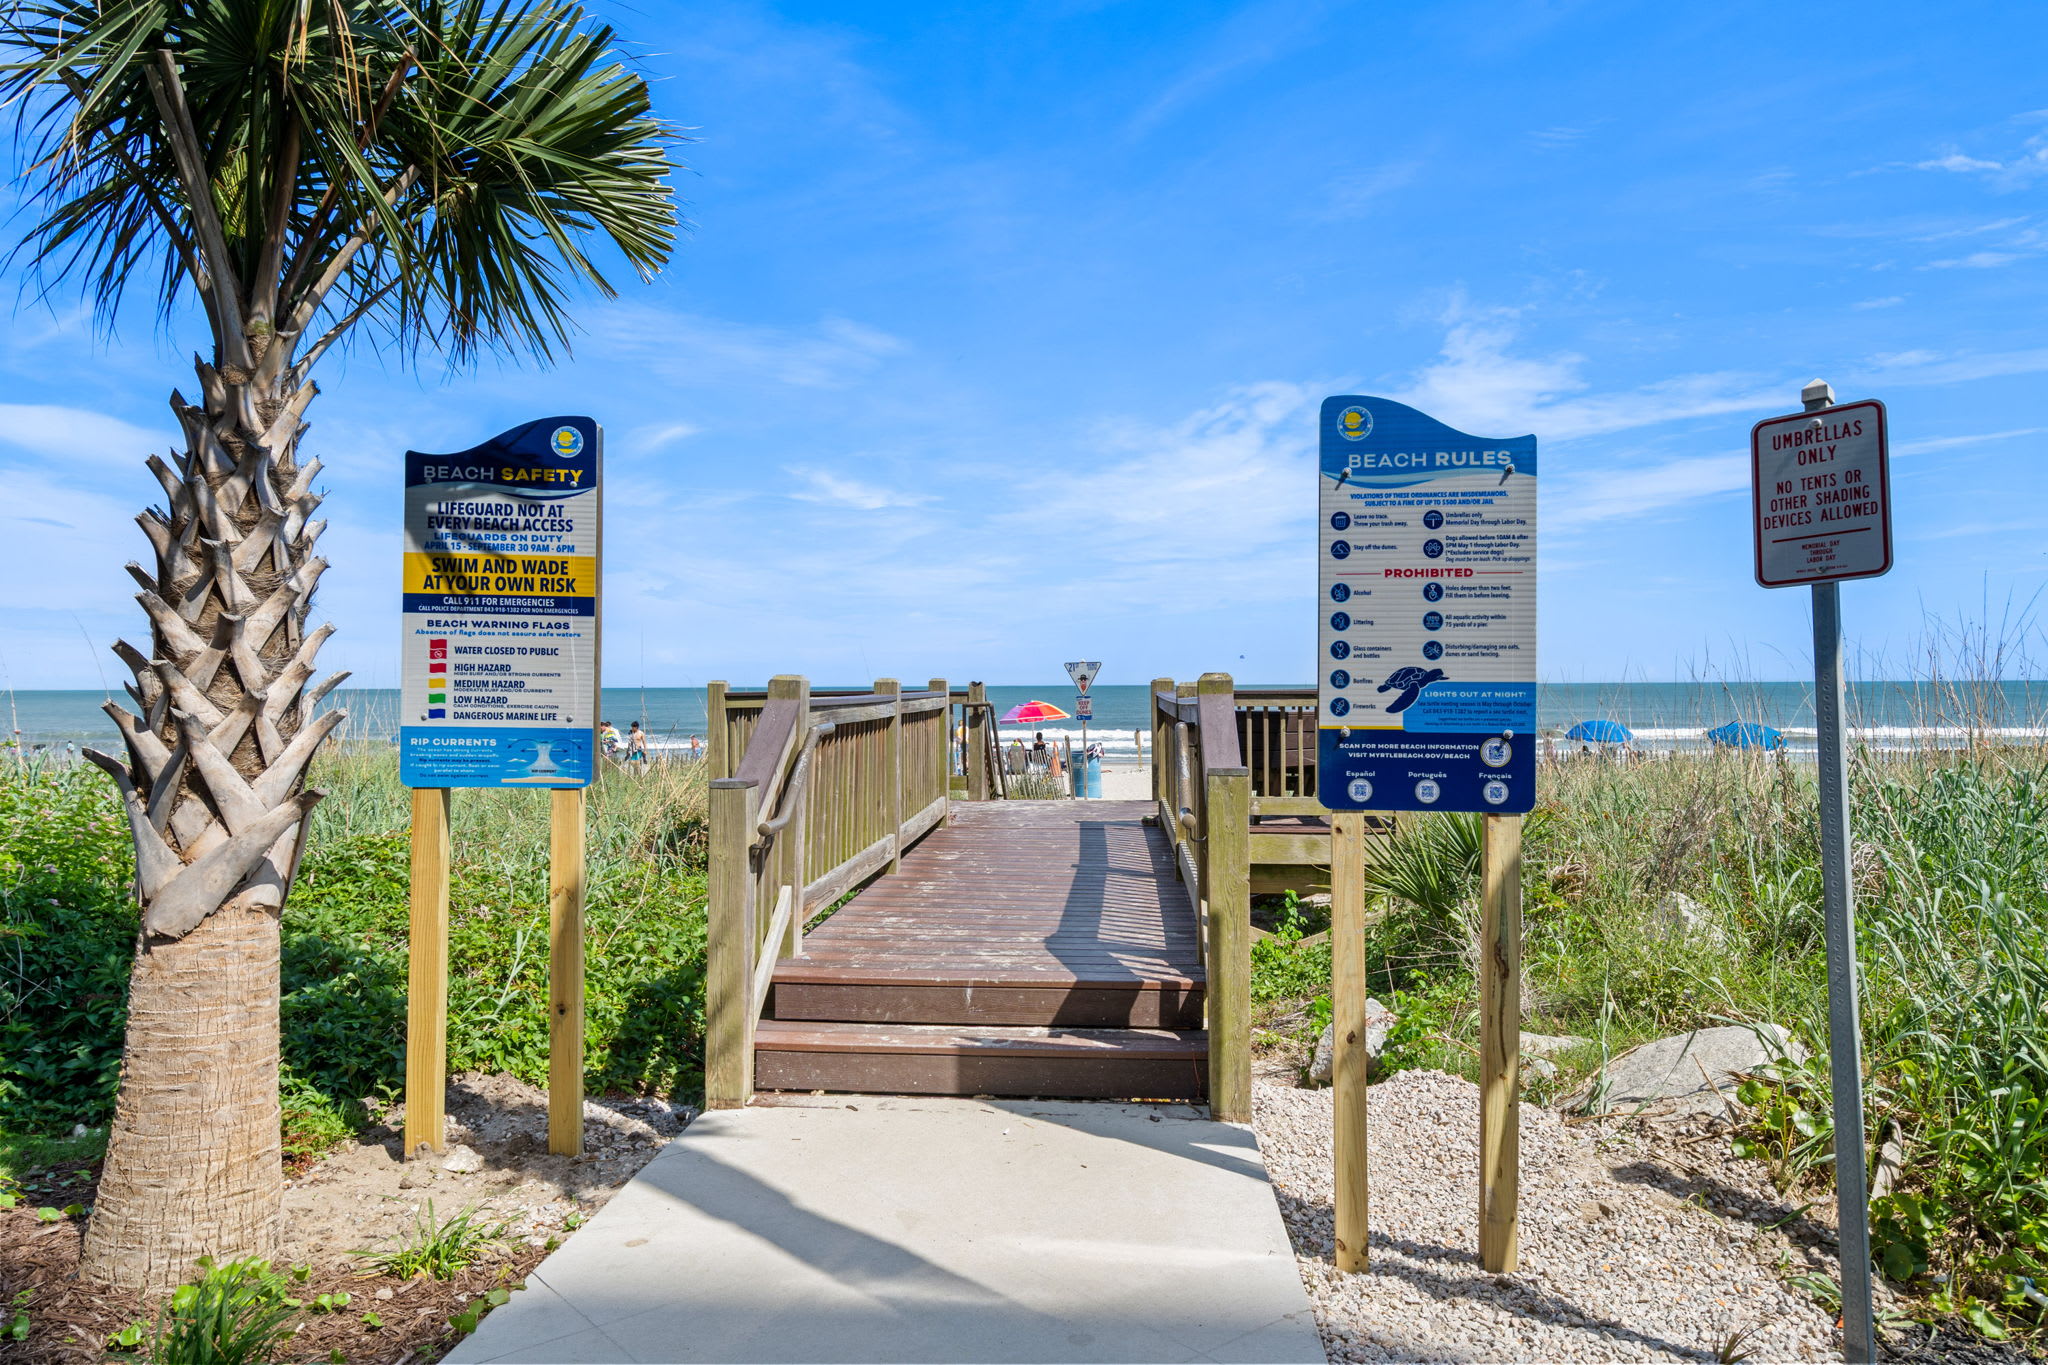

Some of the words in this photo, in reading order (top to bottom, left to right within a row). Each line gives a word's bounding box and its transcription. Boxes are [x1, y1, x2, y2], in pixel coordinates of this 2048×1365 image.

[1773, 420, 1863, 450] UMBRELLAS
[1348, 453, 1426, 468] BEACH
[1436, 451, 1512, 466] RULES
[1798, 445, 1837, 466] ONLY
[423, 466, 493, 480] BEACH
[502, 467, 584, 482] SAFETY
[1776, 480, 1792, 495] NO
[1800, 473, 1837, 491] TENTS
[1845, 470, 1861, 485] OR
[1770, 495, 1807, 513] OTHER
[1816, 485, 1870, 506] SHADING
[437, 502, 513, 516] LIFEGUARD
[519, 504, 545, 517] NOT
[547, 504, 565, 517] AT
[1764, 510, 1812, 530] DEVICES
[1820, 501, 1878, 522] ALLOWED
[428, 517, 470, 530] EVERY
[474, 517, 519, 531] BEACH
[523, 518, 573, 532] ACCESS
[434, 533, 507, 542] LIFEGUARDS
[511, 534, 527, 542] ON
[532, 535, 563, 543] DUTY
[424, 542, 449, 550] APRIL
[468, 543, 516, 552] SEPTEMBER
[518, 544, 529, 552] 30
[531, 544, 549, 552] 9AM
[556, 545, 575, 553] 6PM
[432, 557, 478, 573] SWIM
[482, 559, 517, 574] AND
[522, 560, 568, 575] WADE
[1385, 569, 1474, 577] PROHIBITED
[423, 575, 443, 590] AT
[445, 576, 490, 591] YOUR
[495, 576, 534, 592] OWN
[541, 577, 577, 593] RISK
[443, 597, 462, 605] CALL
[464, 597, 479, 605] 911
[482, 597, 498, 606] FOR
[500, 598, 555, 607] EMERGENCIES
[427, 620, 467, 628] BEACH
[471, 620, 529, 629] WARNING
[533, 621, 570, 630] FLAGS
[478, 629, 495, 637] does
[538, 630, 554, 638] safe
[454, 646, 482, 655] WATER
[484, 647, 515, 655] CLOSED
[517, 647, 527, 656] TO
[530, 647, 559, 656] PUBLIC
[454, 664, 475, 672] HIGH
[478, 664, 511, 672] HAZARD
[454, 680, 489, 689] MEDIUM
[492, 680, 525, 689] HAZARD
[454, 696, 472, 704] LOW
[475, 696, 508, 705] HAZARD
[454, 712, 504, 720] DANGEROUS
[506, 712, 539, 721] MARINE
[541, 713, 557, 721] LIFE
[410, 738, 429, 746] RIP
[433, 738, 497, 746] CURRENTS
[1346, 770, 1376, 778] Español
[1408, 771, 1447, 779] Português
